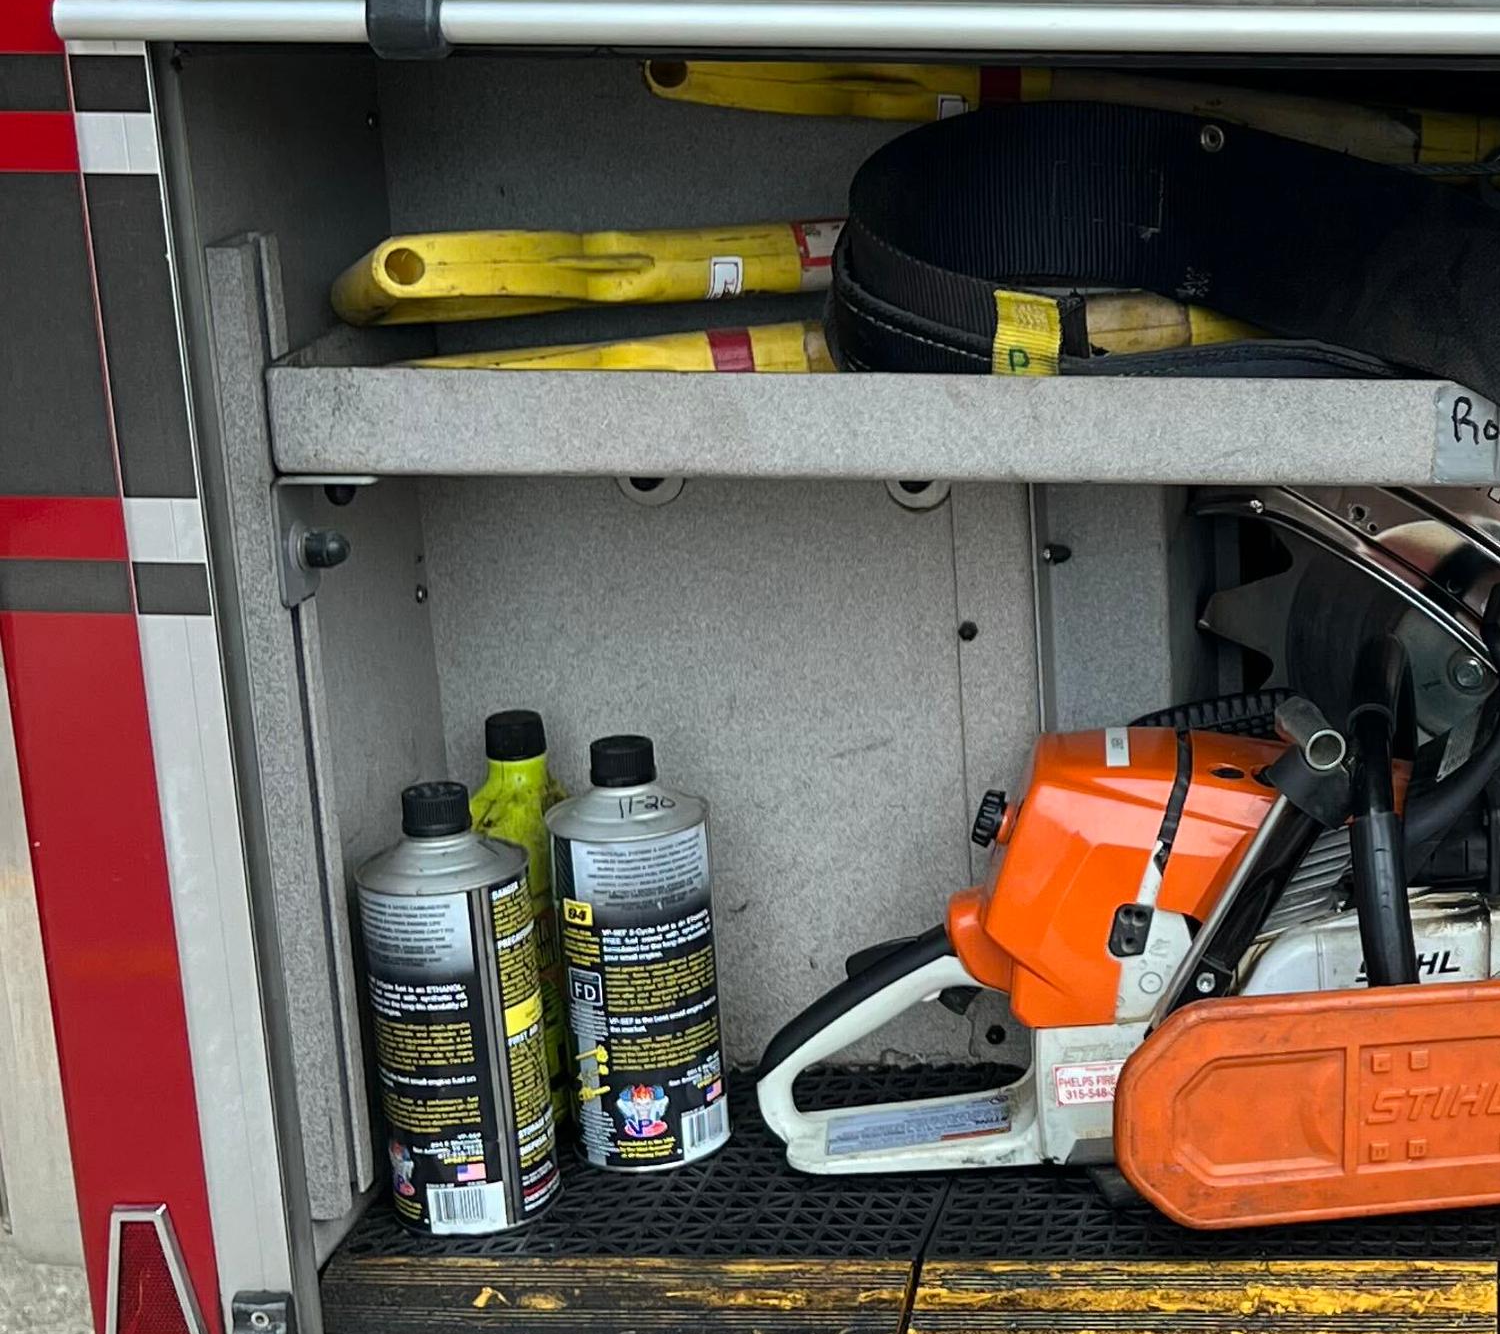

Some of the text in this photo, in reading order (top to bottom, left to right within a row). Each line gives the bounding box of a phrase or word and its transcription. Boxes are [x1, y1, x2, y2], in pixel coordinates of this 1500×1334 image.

[619, 795, 676, 819] 11-20
[568, 908, 587, 922] 94
[574, 981, 596, 1001] FD
